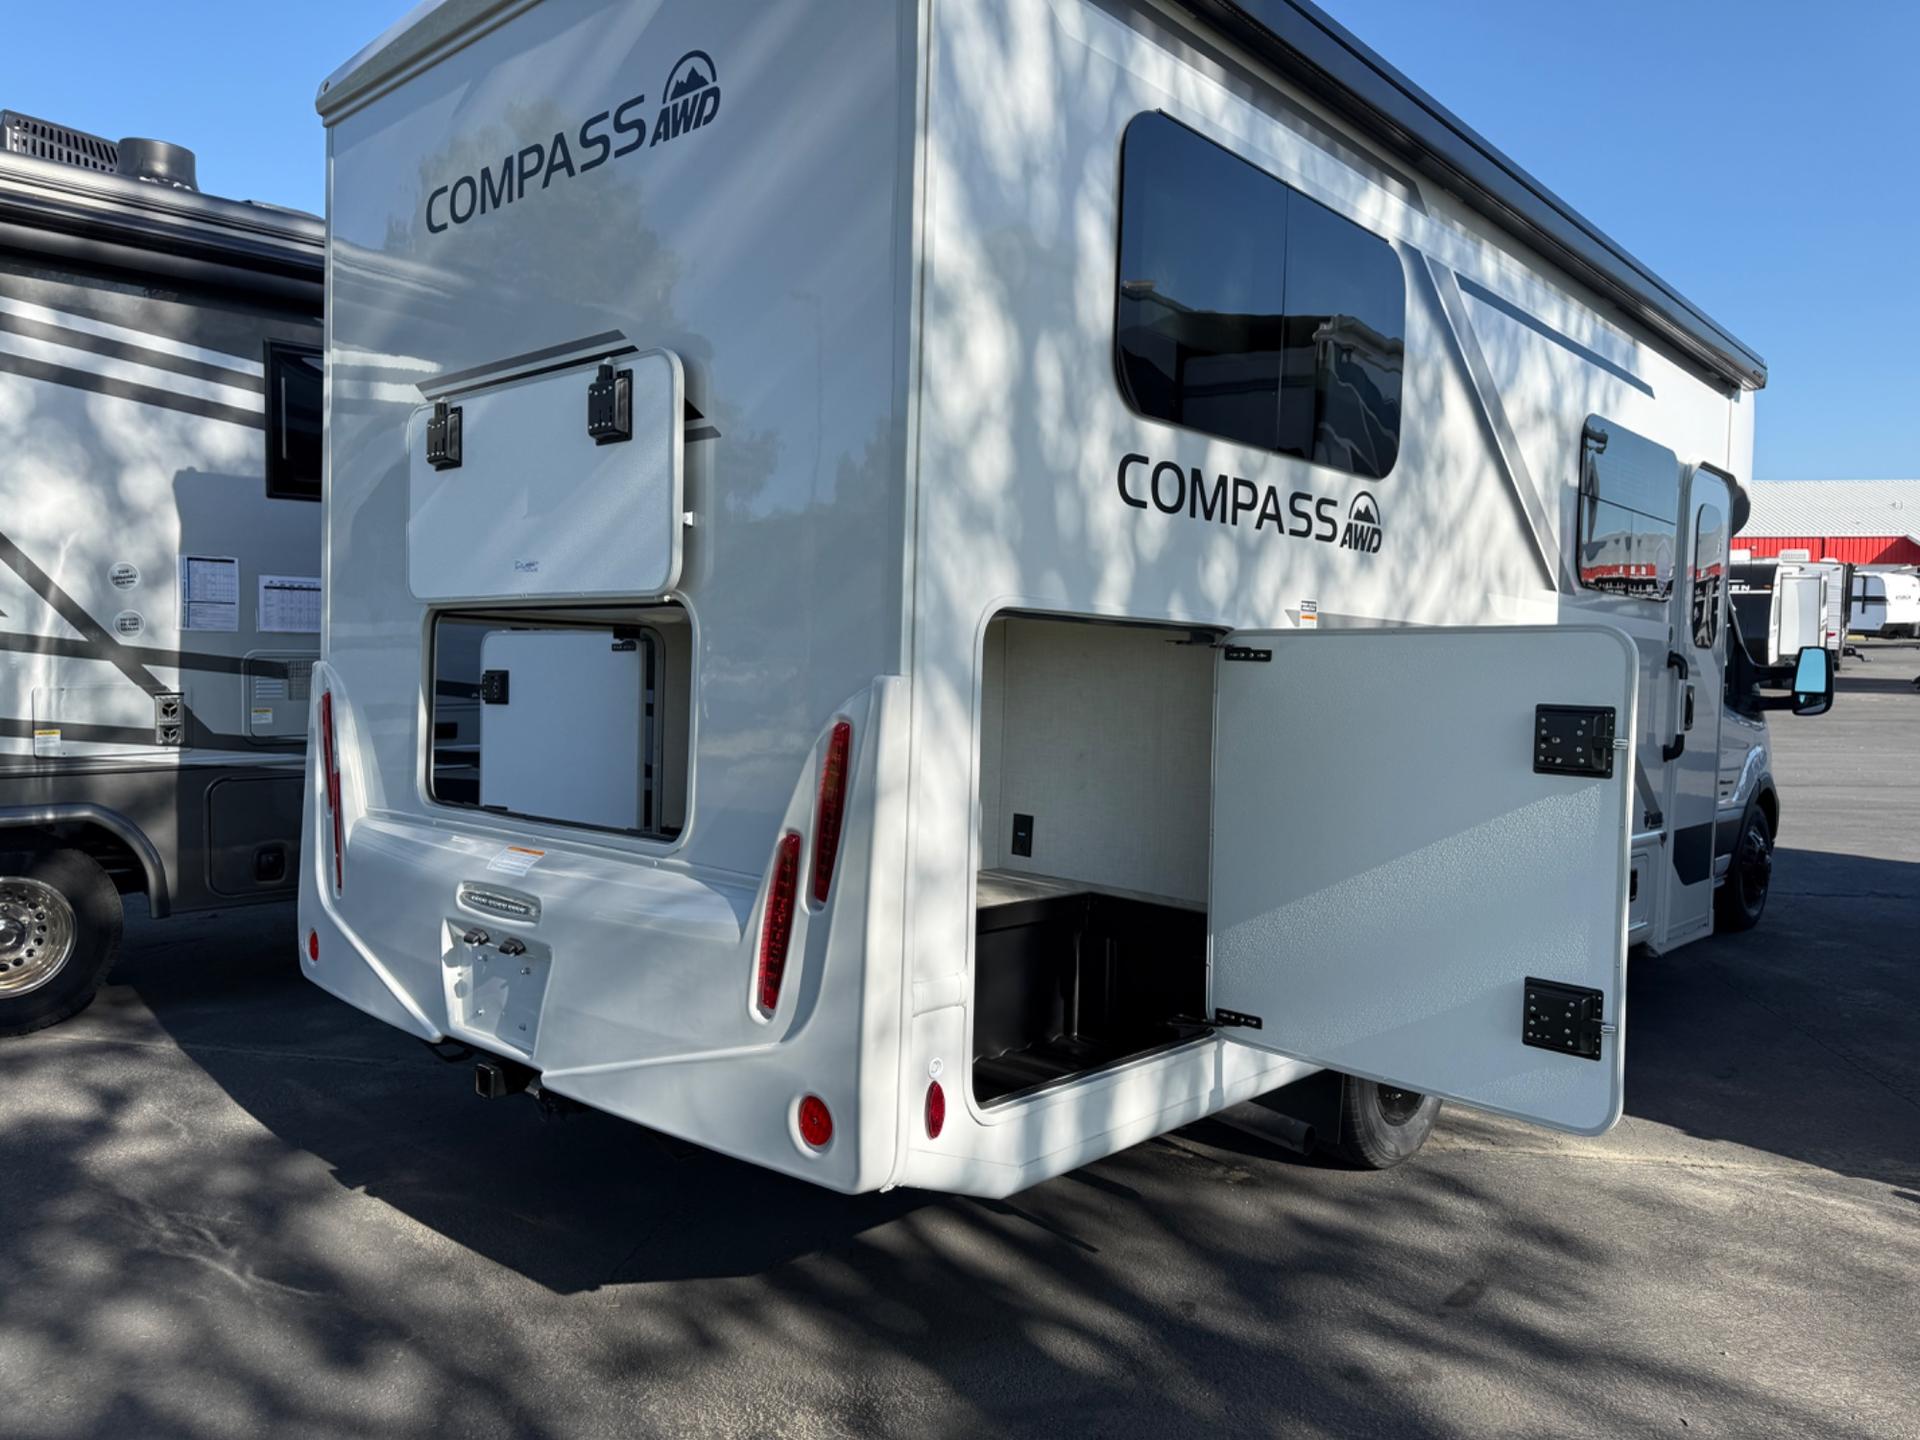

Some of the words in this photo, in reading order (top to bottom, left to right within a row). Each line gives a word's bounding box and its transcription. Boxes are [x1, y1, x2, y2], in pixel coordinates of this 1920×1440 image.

[425, 94, 647, 235] COMPASS
[649, 85, 721, 148] AWD
[1117, 453, 1338, 543] COMPASS
[1340, 521, 1383, 554] AWD
